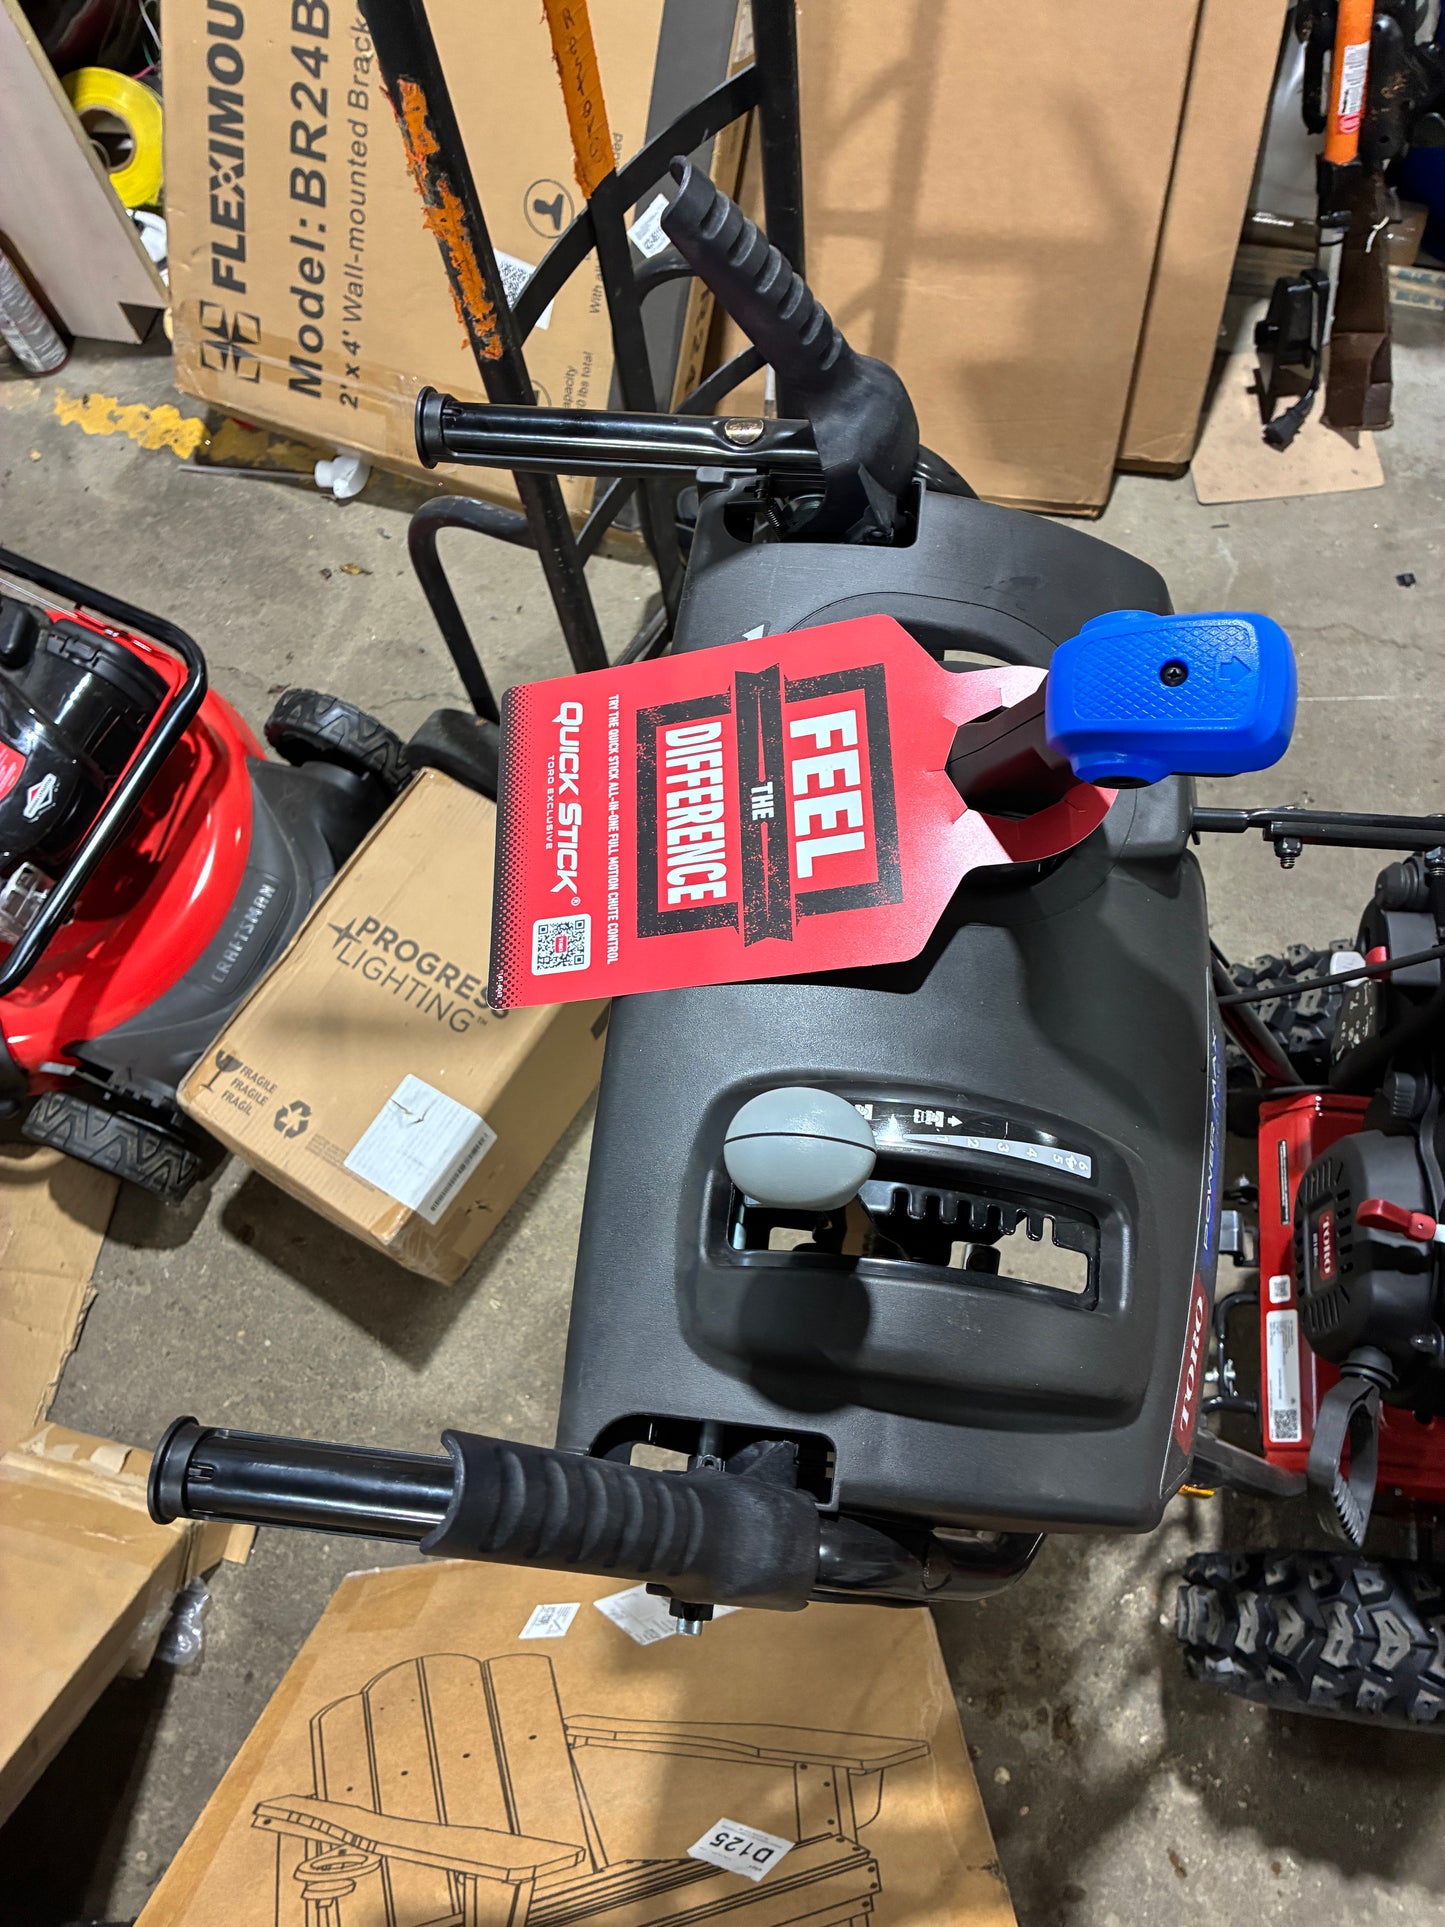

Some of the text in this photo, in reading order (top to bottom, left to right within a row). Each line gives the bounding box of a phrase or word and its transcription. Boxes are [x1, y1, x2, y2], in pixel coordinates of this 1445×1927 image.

[288, 0, 331, 399] Model: BR24B
[342, 120, 369, 322] Wall-mounted
[341, 330, 361, 356] 4'
[345, 361, 361, 380] x
[581, 351, 594, 378] total
[338, 384, 360, 410] 2'
[578, 382, 590, 399] lbs
[551, 701, 584, 796] QUICK
[545, 755, 555, 850] TORO EXCLUSIVE
[665, 721, 728, 905] DIFFERENCE
[750, 782, 774, 820] THE
[790, 709, 866, 879] FEEL
[607, 694, 620, 965] TRY THE QUICK STICK ALL-IN-ONE FULL MOTION CHUTE CONTROL
[212, 883, 277, 985] CRAFTSMAN
[230, 1077, 268, 1106] FRAGILE
[240, 1066, 278, 1094] FRAGILE
[967, 1138, 980, 1149] 2
[997, 1142, 1010, 1153] 3
[1026, 1147, 1038, 1159] 4
[1053, 1154, 1064, 1164] 5
[1078, 1161, 1088, 1171] 6
[1203, 1027, 1218, 1251] POWER MAX
[1322, 1215, 1331, 1275] TORO
[1178, 1294, 1206, 1431] TORO
[709, 1831, 774, 1866] D125
